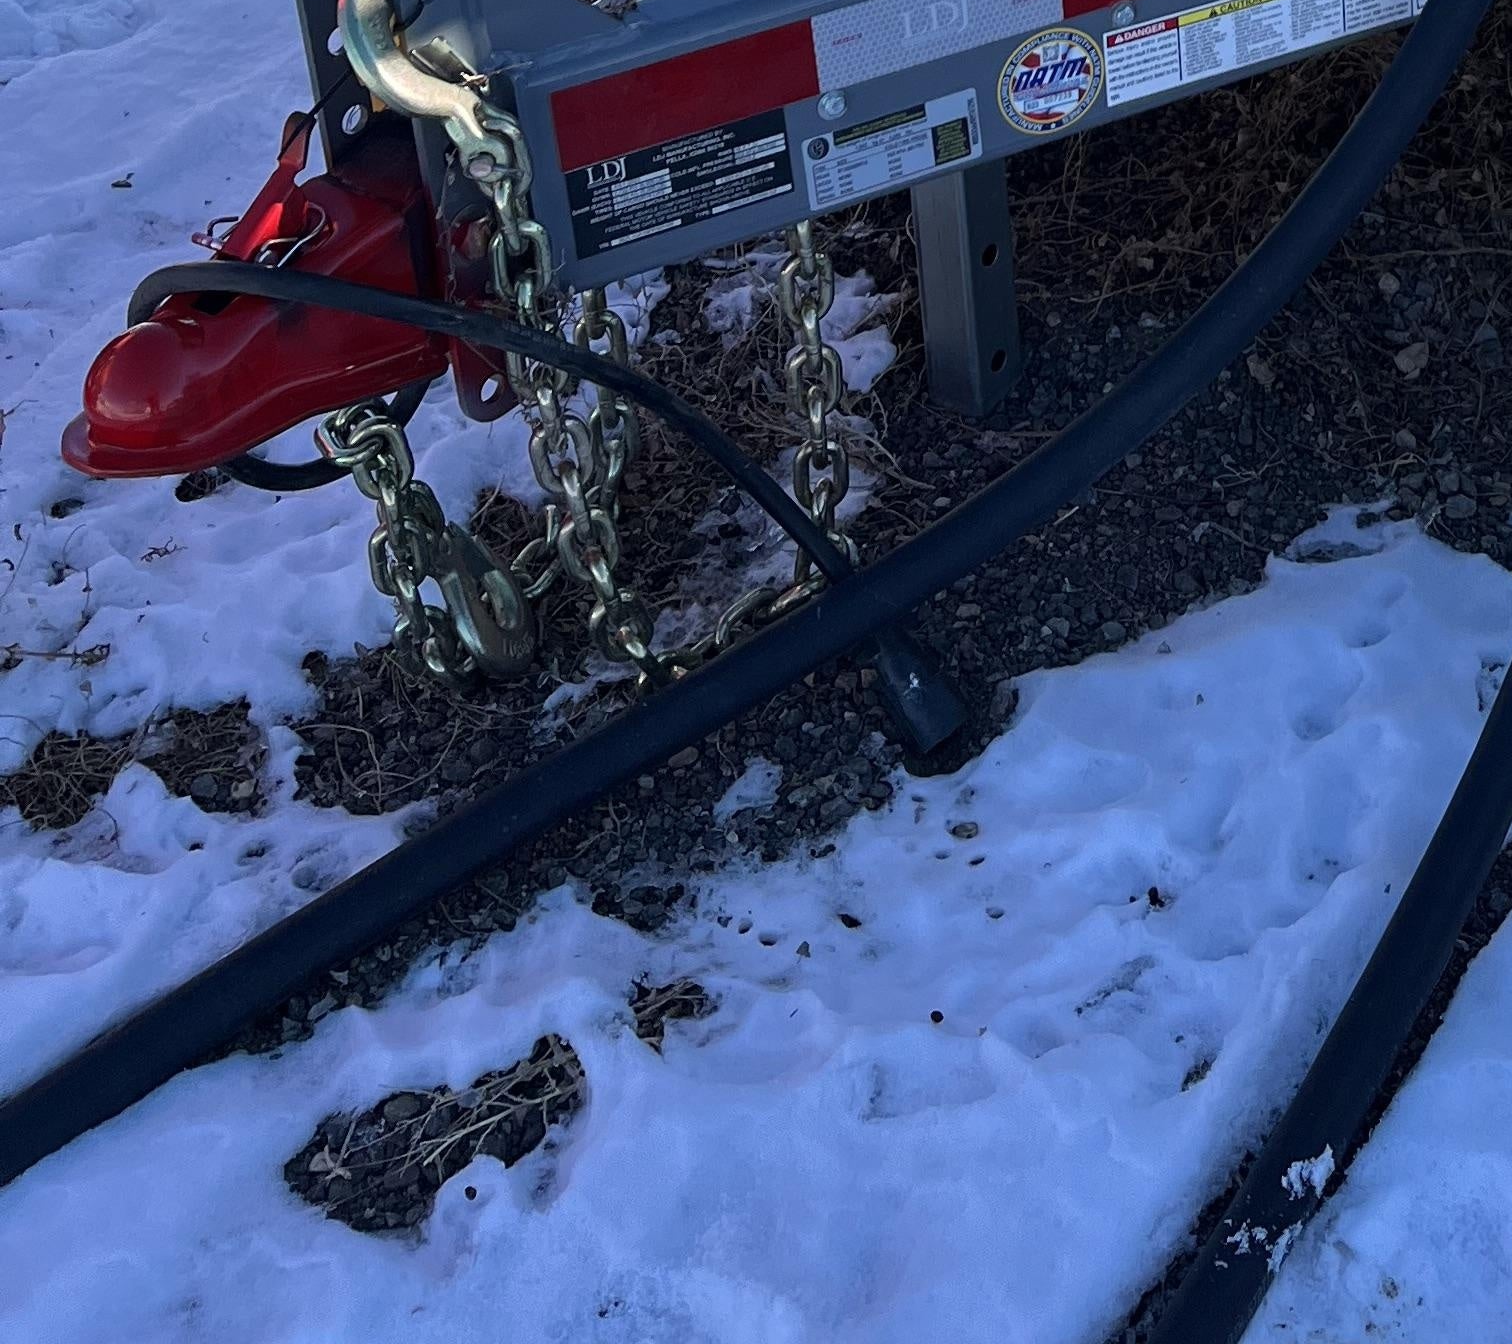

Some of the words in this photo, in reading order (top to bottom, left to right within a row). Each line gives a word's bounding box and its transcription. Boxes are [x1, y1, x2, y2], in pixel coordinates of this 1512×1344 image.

[1124, 21, 1166, 41] DANGER
[1013, 56, 1087, 92] NATM
[587, 157, 626, 185] LDJ
